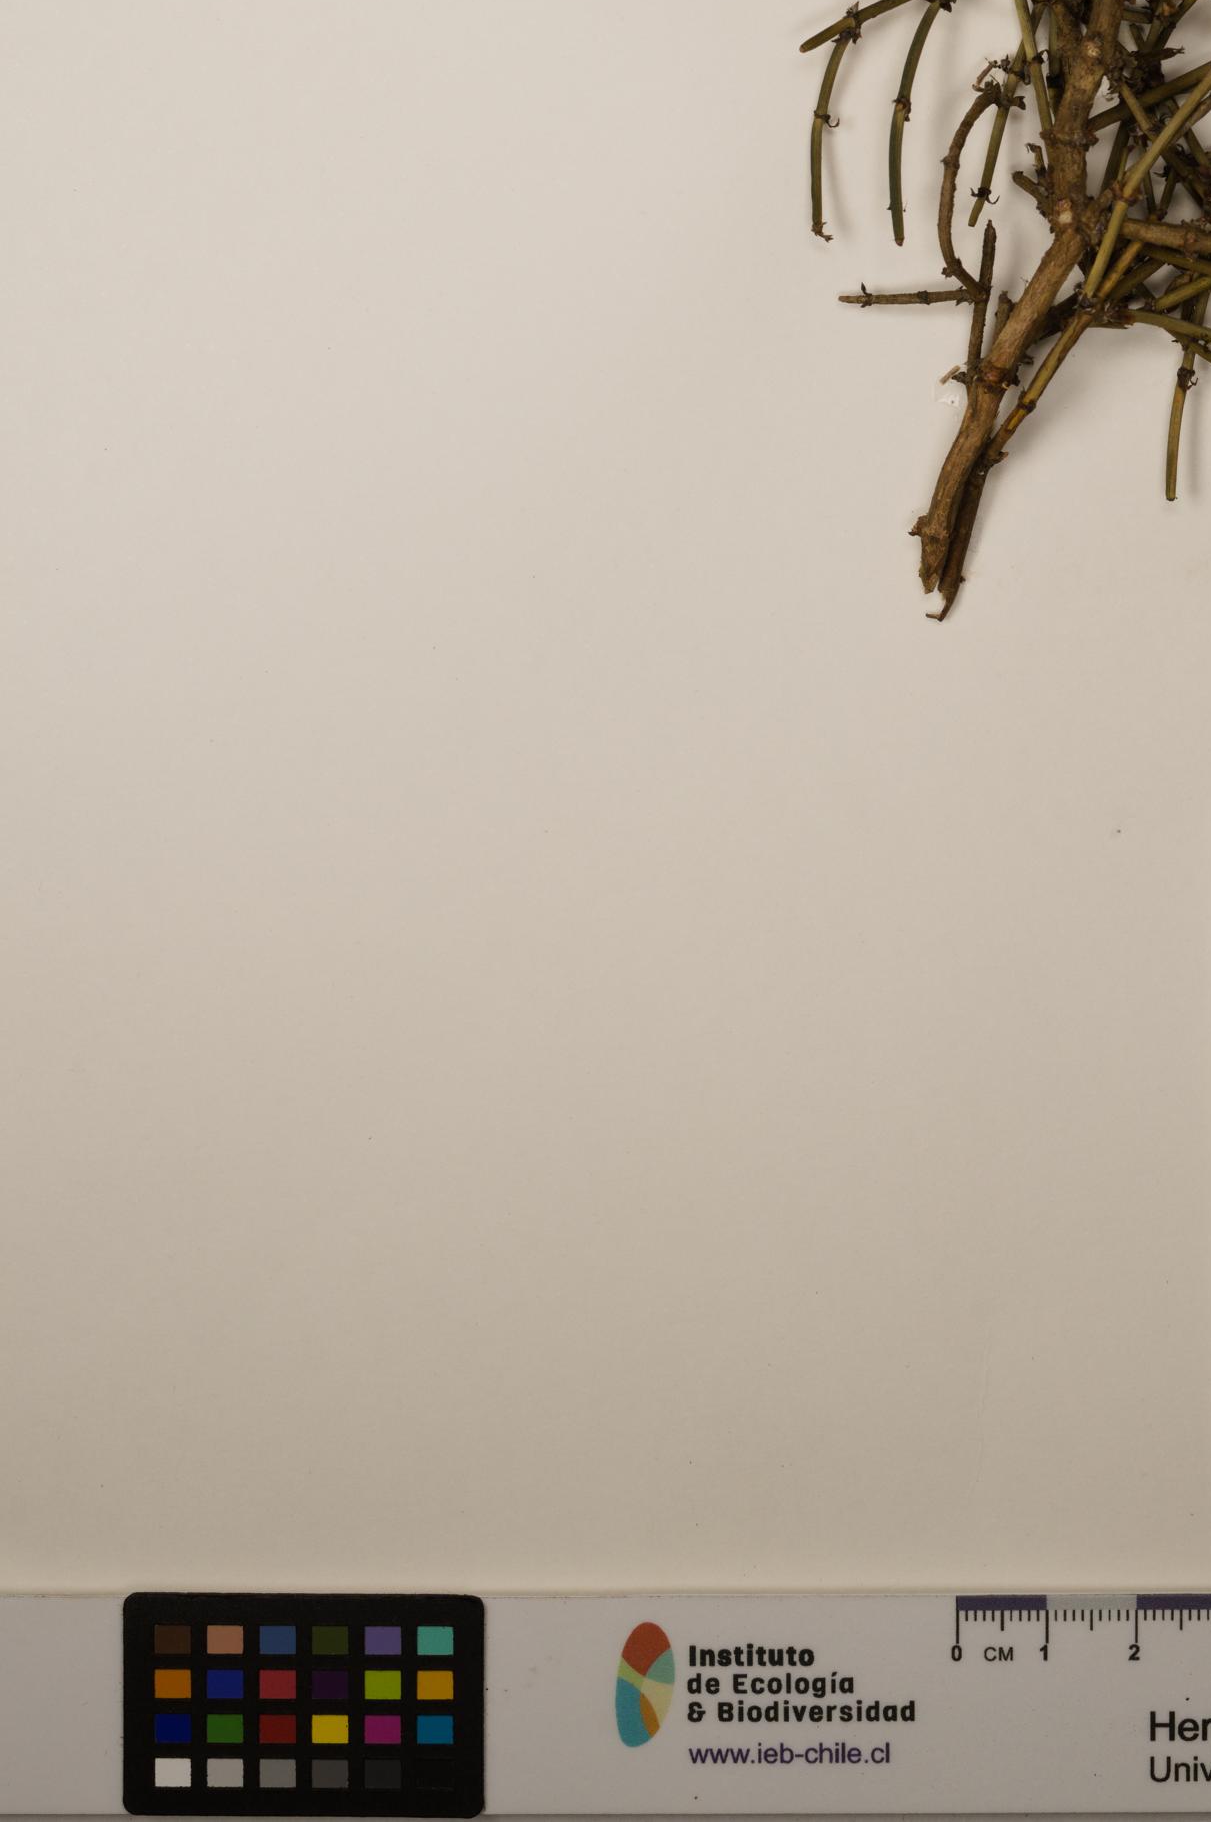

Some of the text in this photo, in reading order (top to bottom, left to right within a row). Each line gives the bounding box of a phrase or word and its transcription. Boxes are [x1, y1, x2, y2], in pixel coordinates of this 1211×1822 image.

[688, 1643, 815, 1667] Instituto
[950, 1644, 963, 1662] 0
[983, 1646, 1014, 1662] CM
[1039, 1643, 1049, 1662] 1
[1127, 1643, 1141, 1661] 2
[686, 1671, 855, 1700] de Ecología
[687, 1699, 916, 1724] & Biodiversidad
[688, 1741, 891, 1765] www.ieb-chile.cl
